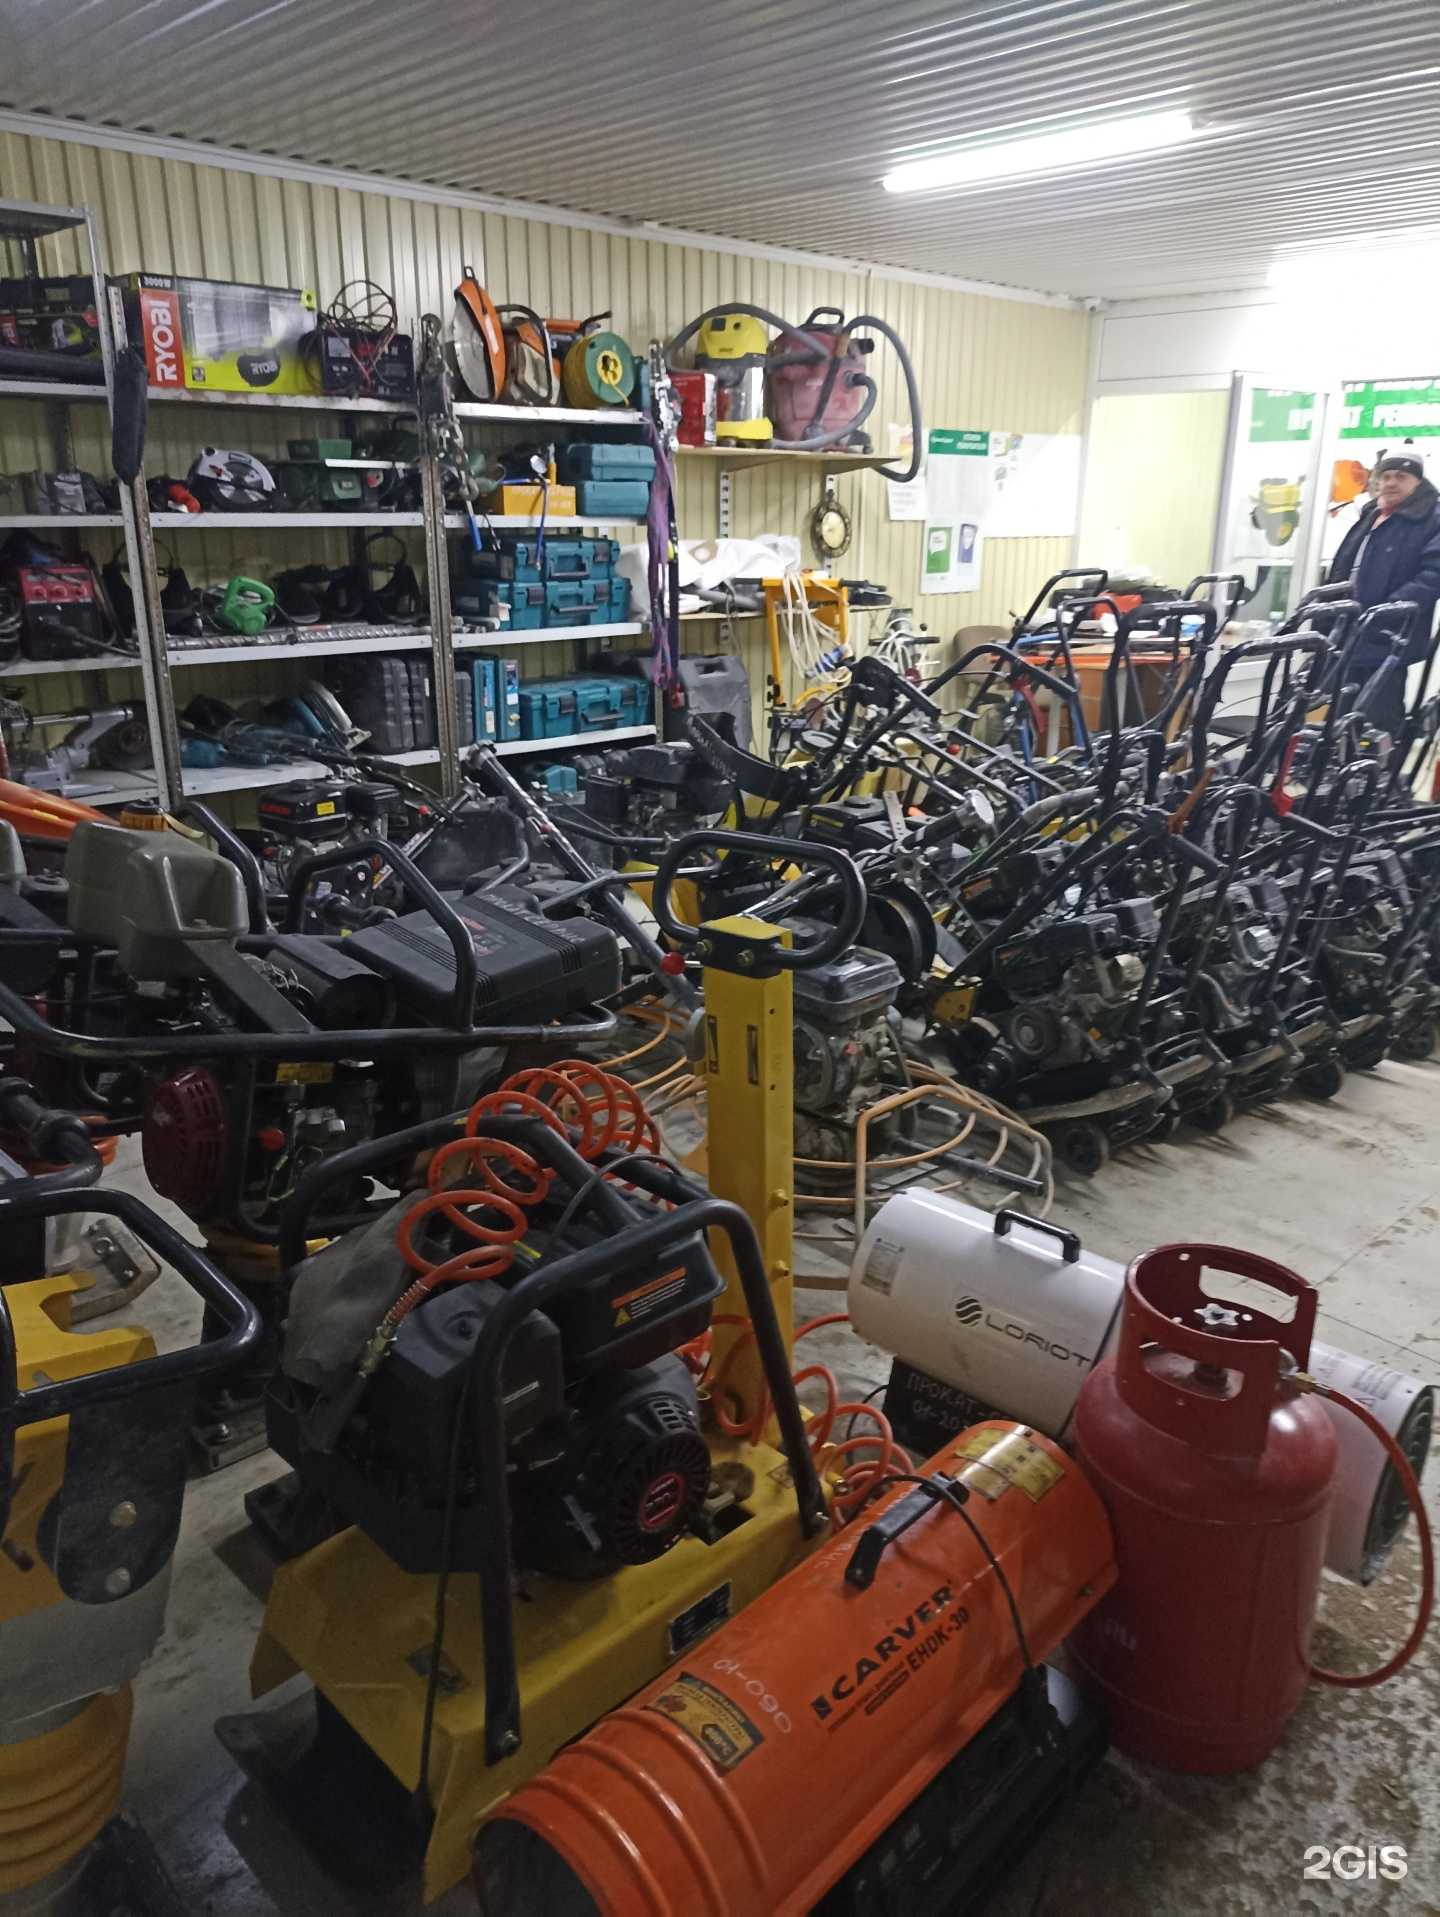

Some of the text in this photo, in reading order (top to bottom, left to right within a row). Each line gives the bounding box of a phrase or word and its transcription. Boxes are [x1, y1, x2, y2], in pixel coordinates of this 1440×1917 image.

[150, 300, 178, 382] RYOBI
[984, 1313, 1092, 1368] LORIOT
[831, 1586, 954, 1701] CARVER
